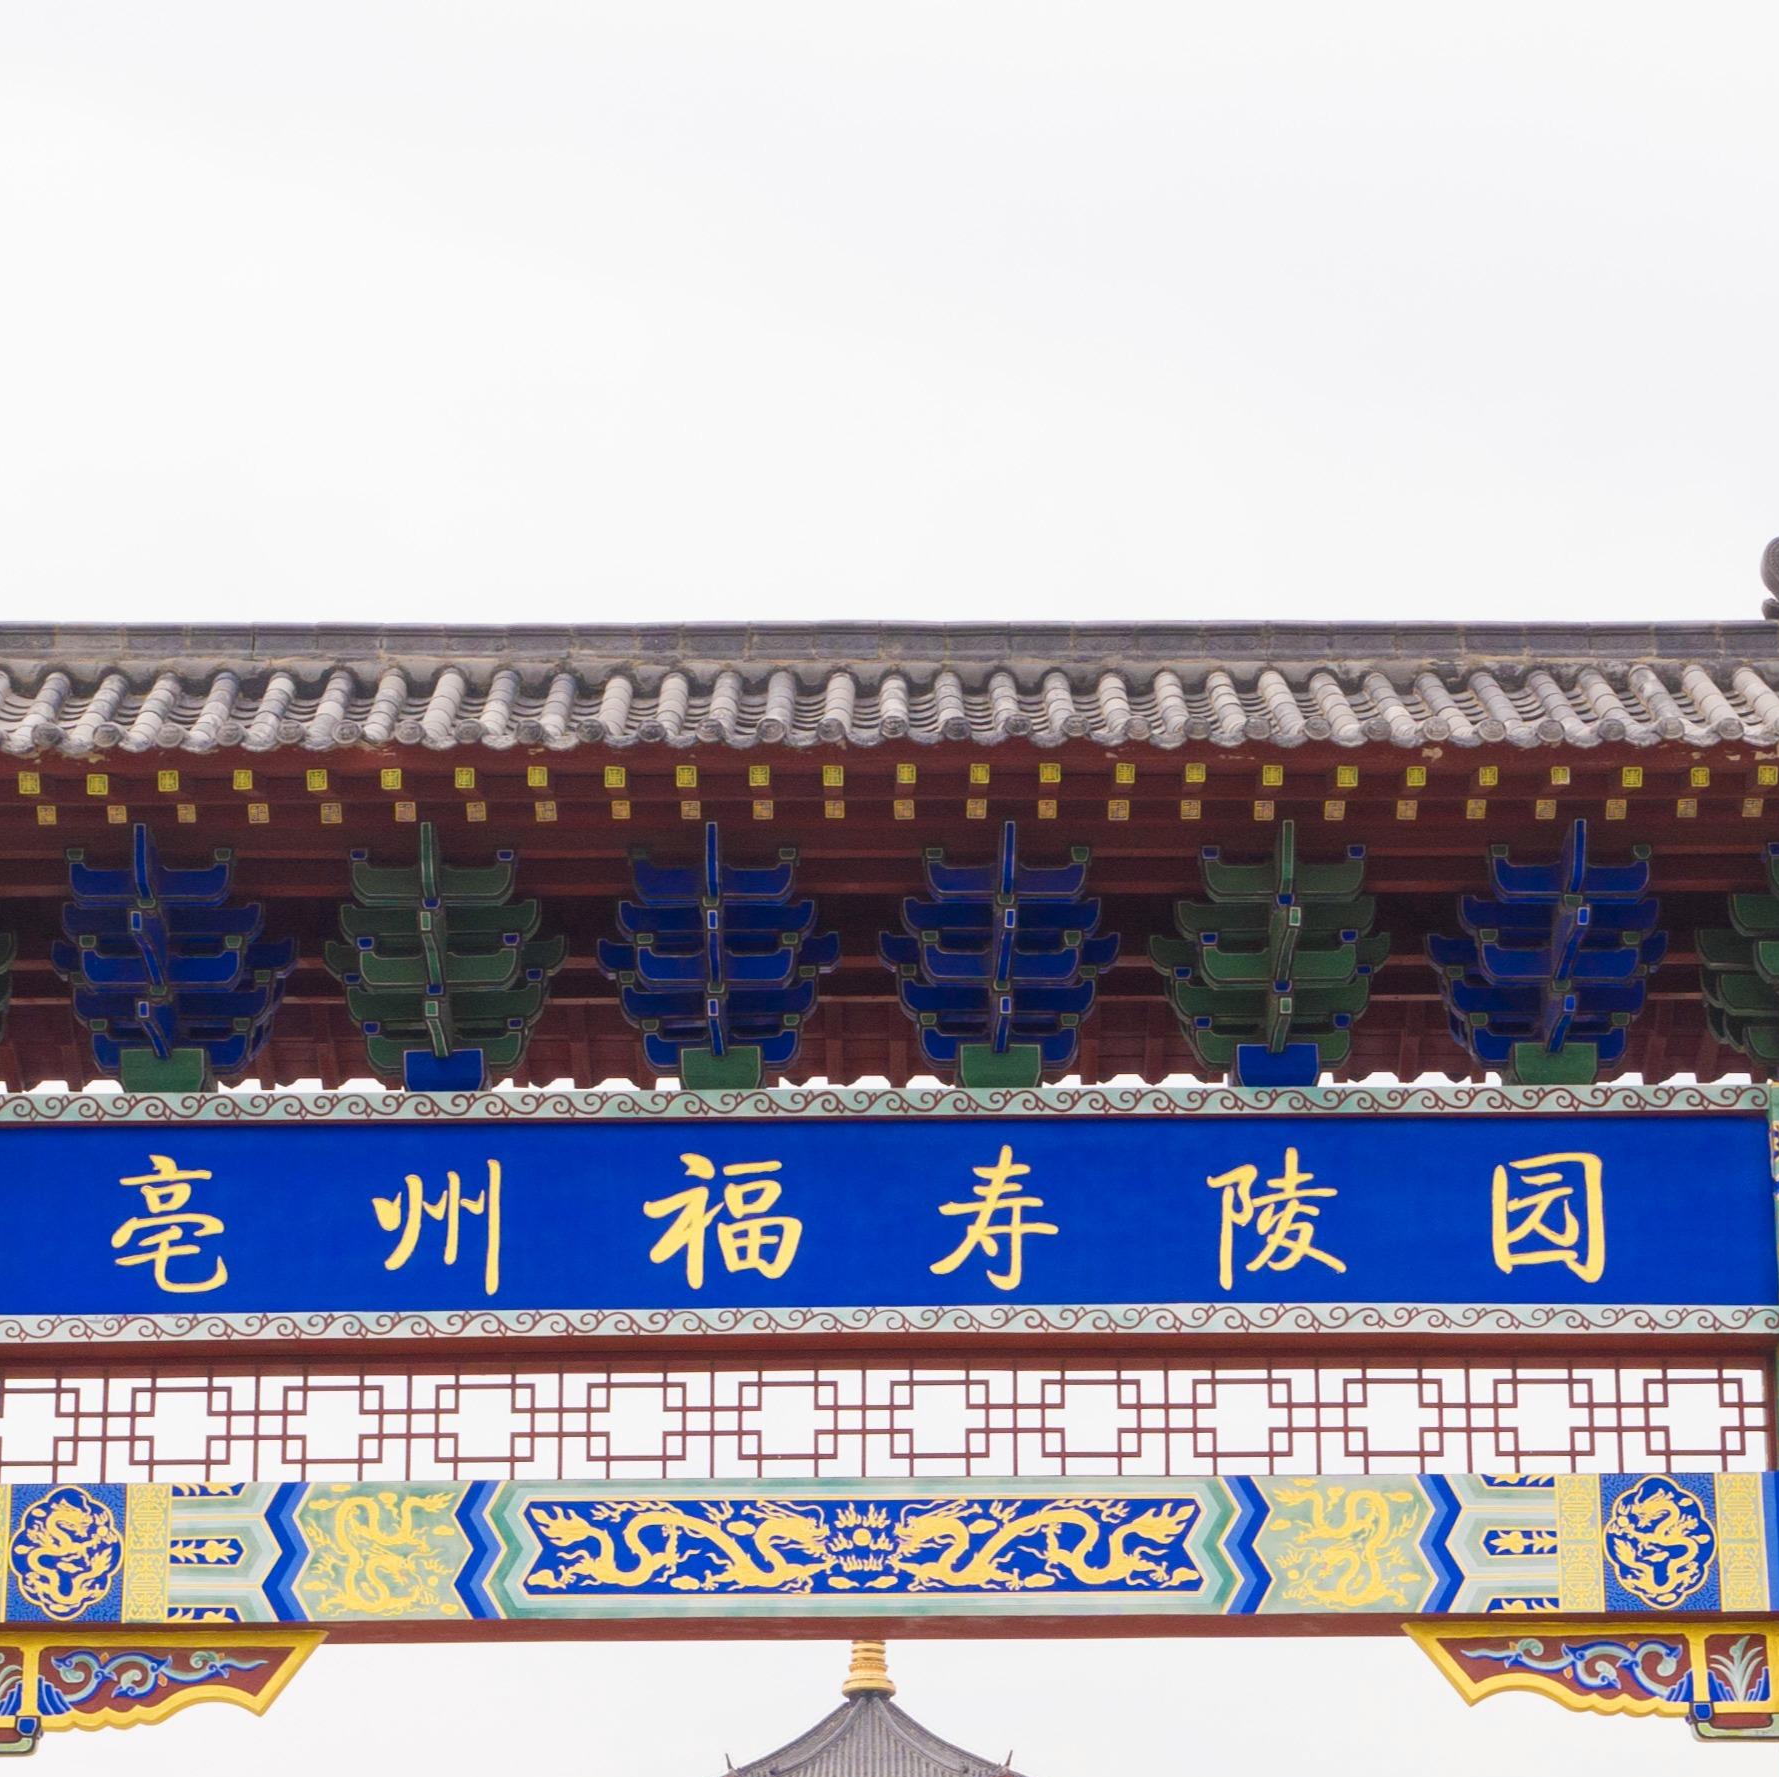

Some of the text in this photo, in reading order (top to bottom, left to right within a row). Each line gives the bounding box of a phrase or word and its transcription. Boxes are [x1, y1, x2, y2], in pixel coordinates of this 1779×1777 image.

[111, 1143, 1606, 1296] 亳州福寿陵园
